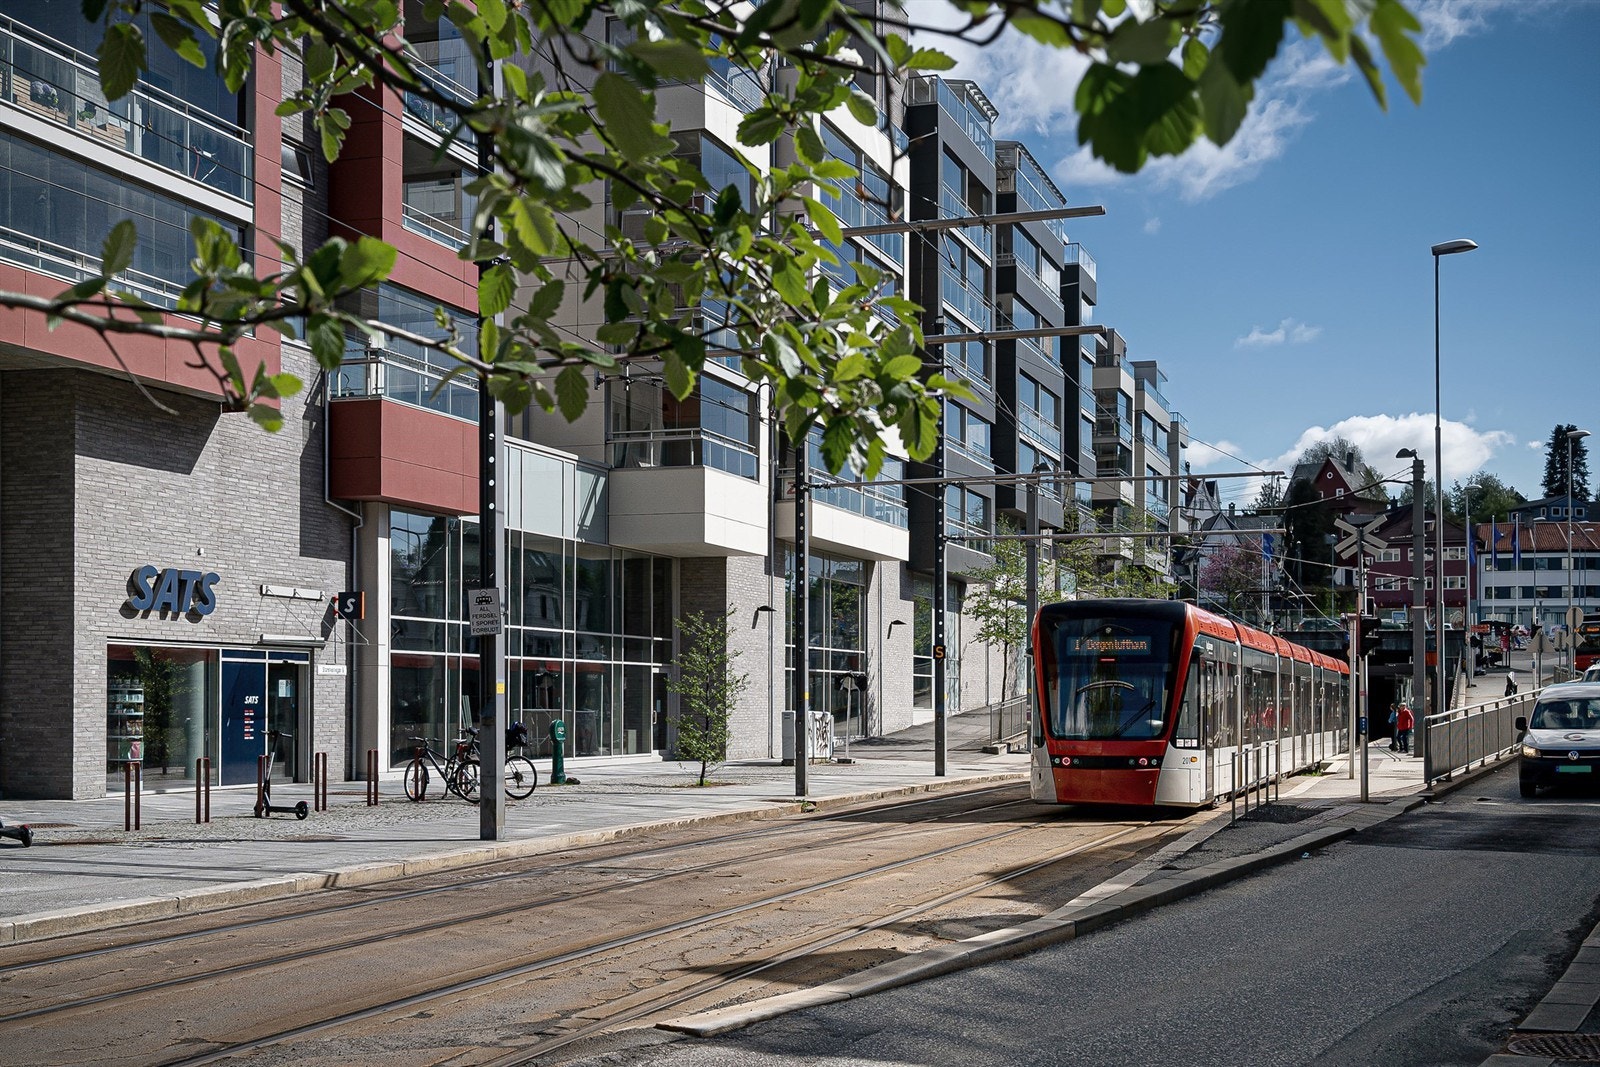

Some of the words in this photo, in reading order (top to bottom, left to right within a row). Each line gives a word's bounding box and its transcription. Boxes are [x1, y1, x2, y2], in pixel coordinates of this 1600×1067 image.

[131, 565, 221, 615] SATS
[344, 598, 356, 613] S
[935, 646, 944, 658] S
[244, 695, 259, 704] SATS
